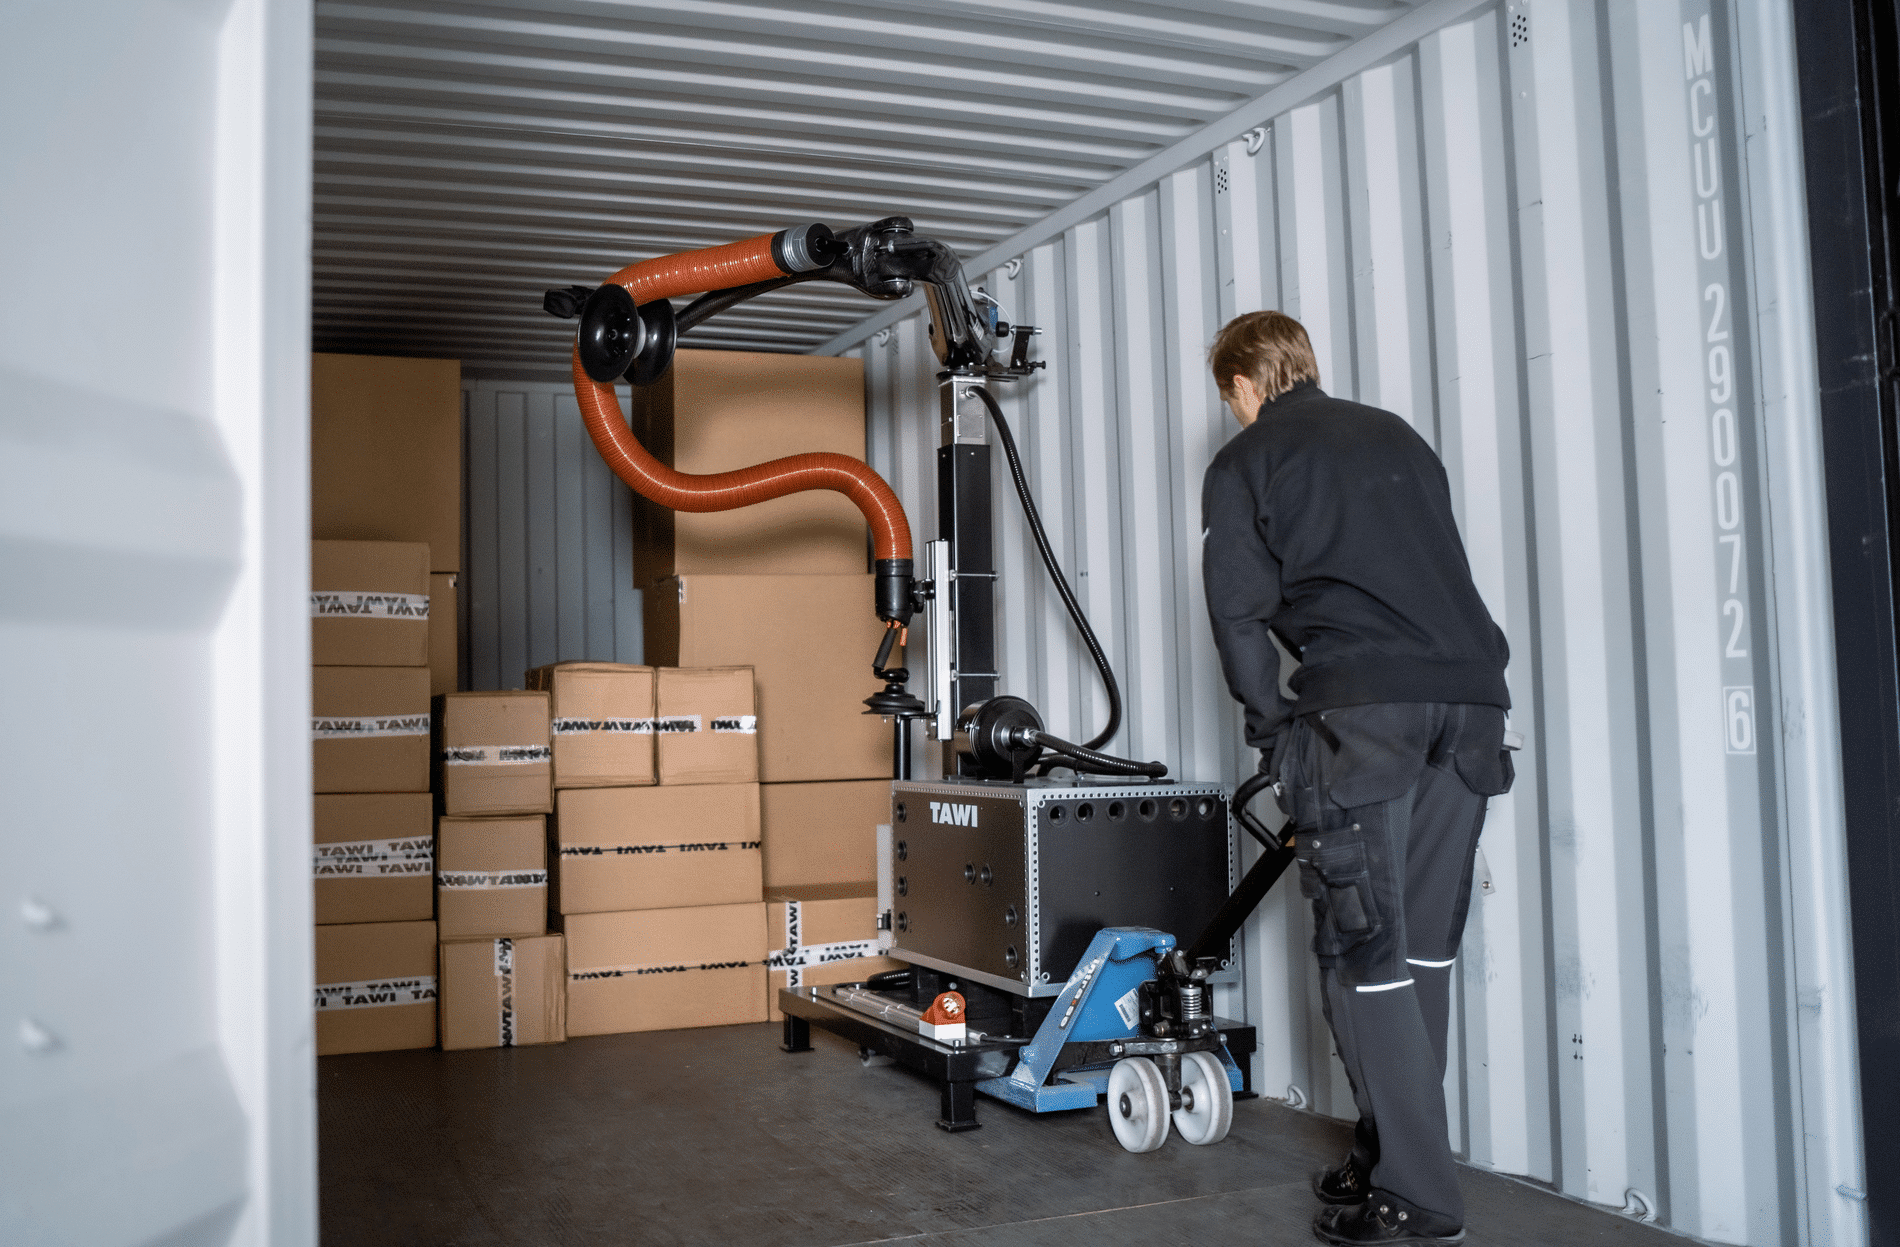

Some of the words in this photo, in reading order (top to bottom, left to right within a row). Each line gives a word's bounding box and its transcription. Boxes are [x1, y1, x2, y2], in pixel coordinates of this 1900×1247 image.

[1683, 13, 1722, 260] MCUU
[1704, 283, 1747, 658] 290072
[1728, 690, 1752, 750] 6
[319, 604, 373, 614] TAWI
[376, 717, 429, 730] TAWI
[929, 801, 978, 828] TAWI
[319, 844, 373, 856] TAWI
[378, 861, 431, 874] TAWI
[820, 951, 865, 962] TAWI
[342, 992, 397, 1006] TAWI
